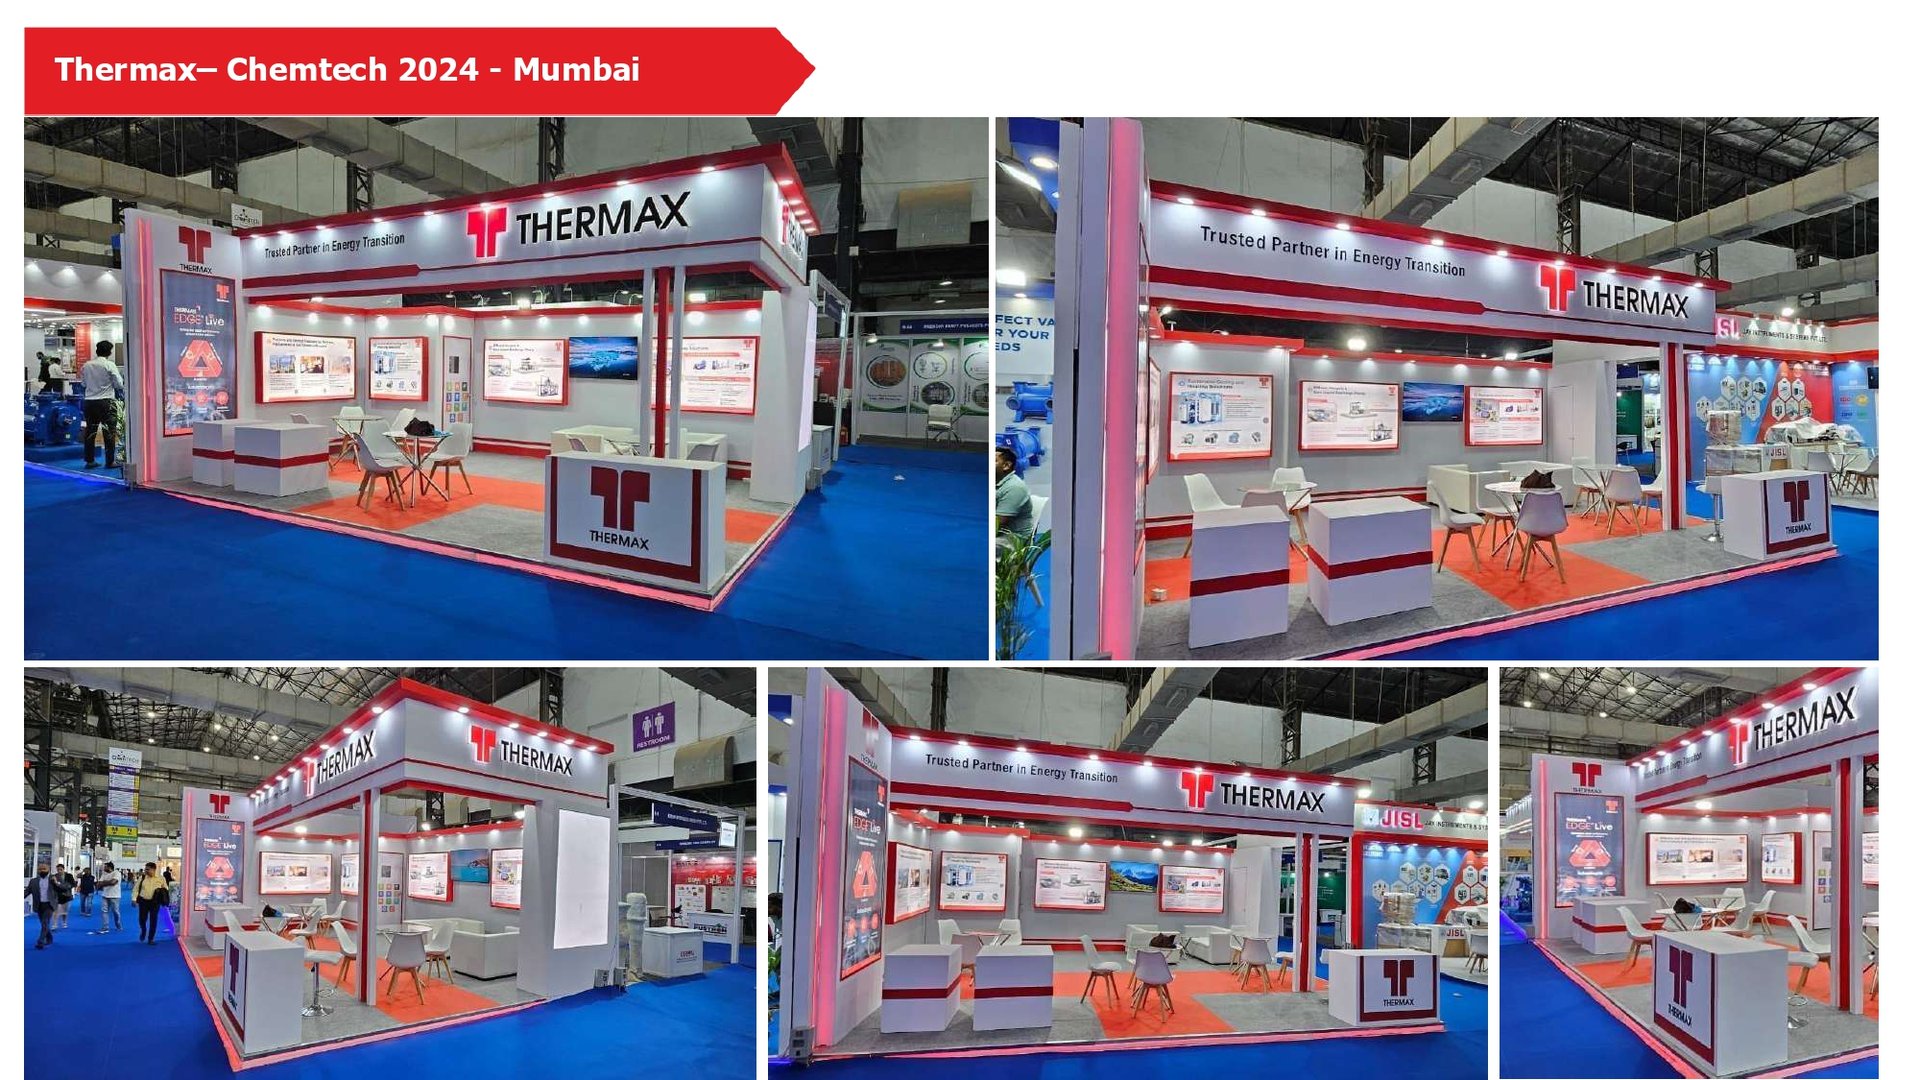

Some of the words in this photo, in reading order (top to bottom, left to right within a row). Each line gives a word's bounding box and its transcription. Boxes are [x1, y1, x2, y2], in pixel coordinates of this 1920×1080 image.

[516, 191, 691, 245] THERMAX
[265, 247, 291, 258] Trusted
[293, 245, 321, 256] Partner
[323, 242, 330, 252] in
[332, 238, 360, 252] Energy
[363, 233, 405, 249] Transition
[1200, 225, 1266, 249] Trusted
[1271, 235, 1330, 259] Partner
[1335, 246, 1347, 261] in
[1353, 249, 1401, 270] Energy
[1405, 256, 1466, 277] Transition
[179, 263, 213, 274] THERMAX
[1583, 280, 1690, 319] THERMAX
[205, 315, 224, 326] Live
[1008, 328, 1050, 340] YOUR
[1770, 447, 1787, 457] JISL
[1785, 522, 1812, 535] THERMAX
[589, 529, 650, 550] THERMAX
[1754, 686, 1856, 751] THERMAX
[636, 735, 670, 749] RESTROOM
[317, 729, 377, 785] THERMAX
[501, 740, 574, 777] THERMAX
[926, 754, 969, 768] Trusted
[972, 759, 1014, 773] Partner
[1017, 763, 1026, 775] in
[1030, 765, 1067, 780] Energy
[1070, 769, 1118, 783] Transition
[1220, 783, 1326, 813] THERMAX
[1381, 809, 1424, 829] JISL
[1594, 821, 1613, 831] Live
[1446, 929, 1465, 937] JISL
[1383, 999, 1415, 1007] THERMAX
